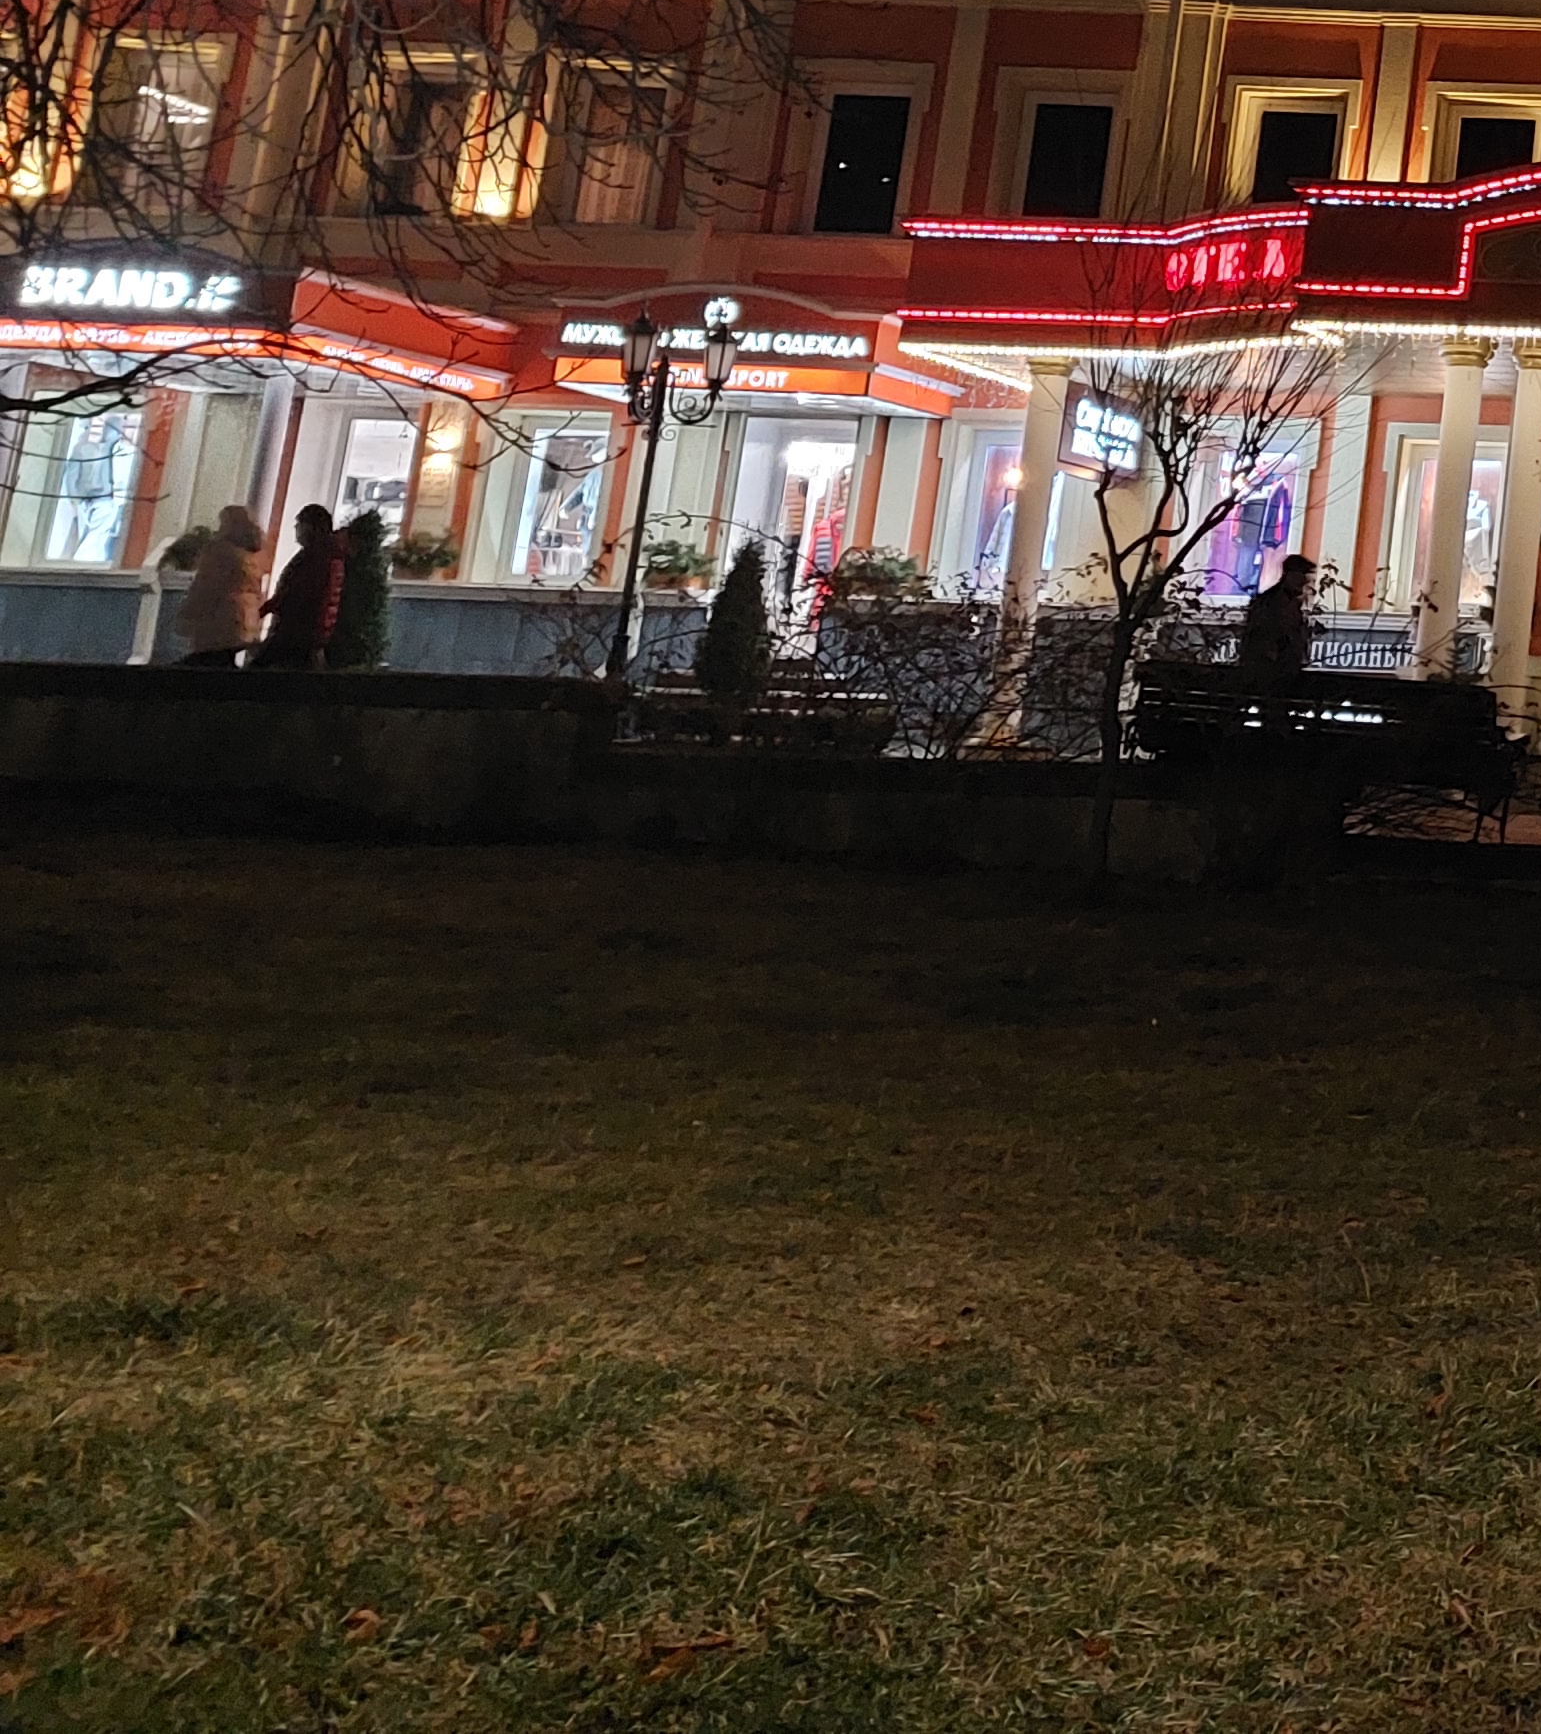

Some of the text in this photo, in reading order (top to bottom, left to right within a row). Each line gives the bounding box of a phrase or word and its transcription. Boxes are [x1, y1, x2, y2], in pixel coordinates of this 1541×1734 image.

[671, 328, 770, 353] ЖЕАЯ
[773, 333, 869, 357] ОДЕЖДА
[727, 366, 790, 388] SPORT
